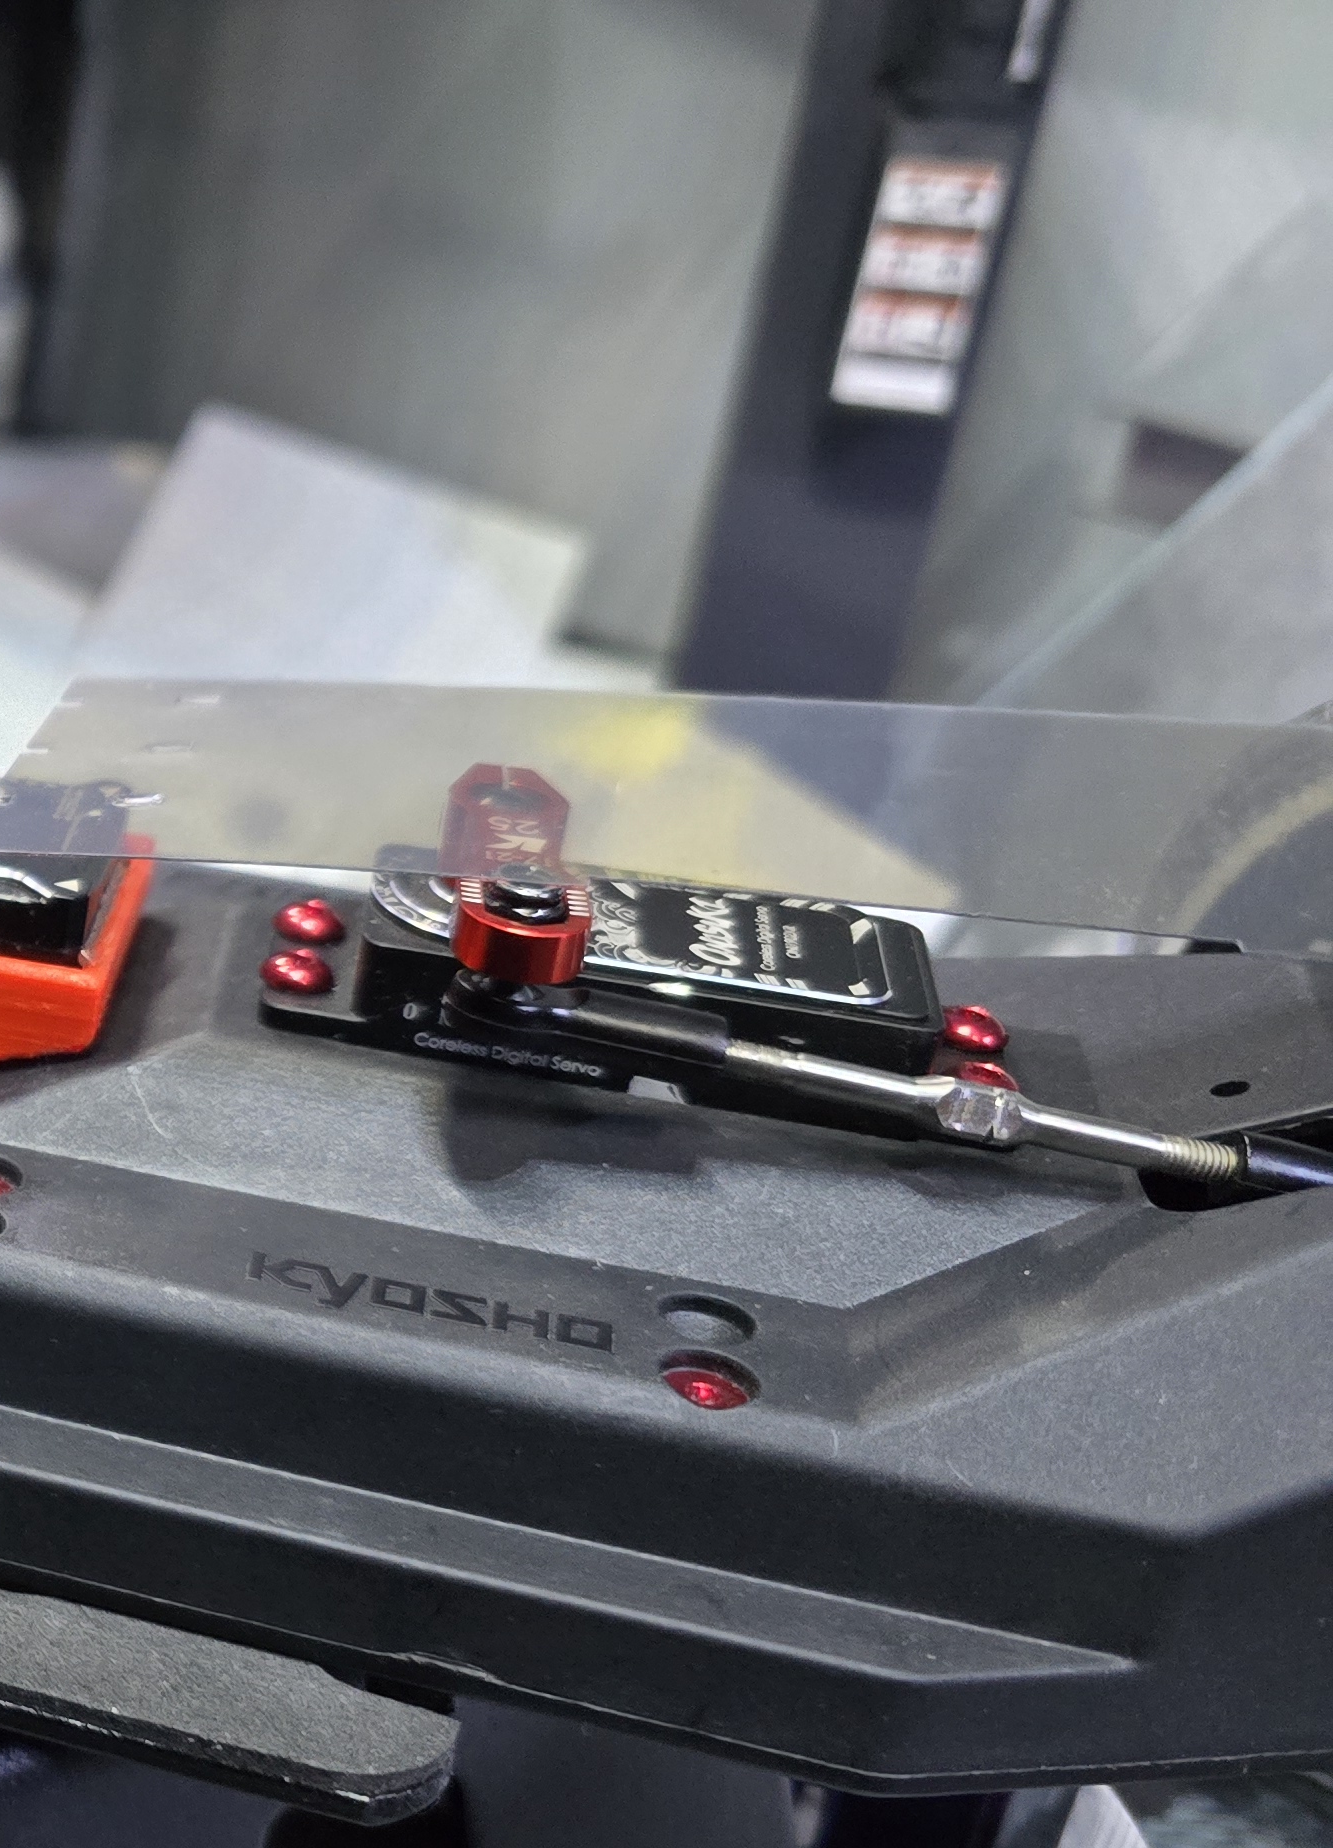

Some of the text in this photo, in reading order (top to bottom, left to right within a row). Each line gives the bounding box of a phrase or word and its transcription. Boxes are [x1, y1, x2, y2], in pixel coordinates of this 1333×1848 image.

[413, 1031, 604, 1077] Coreless Digital Servo
